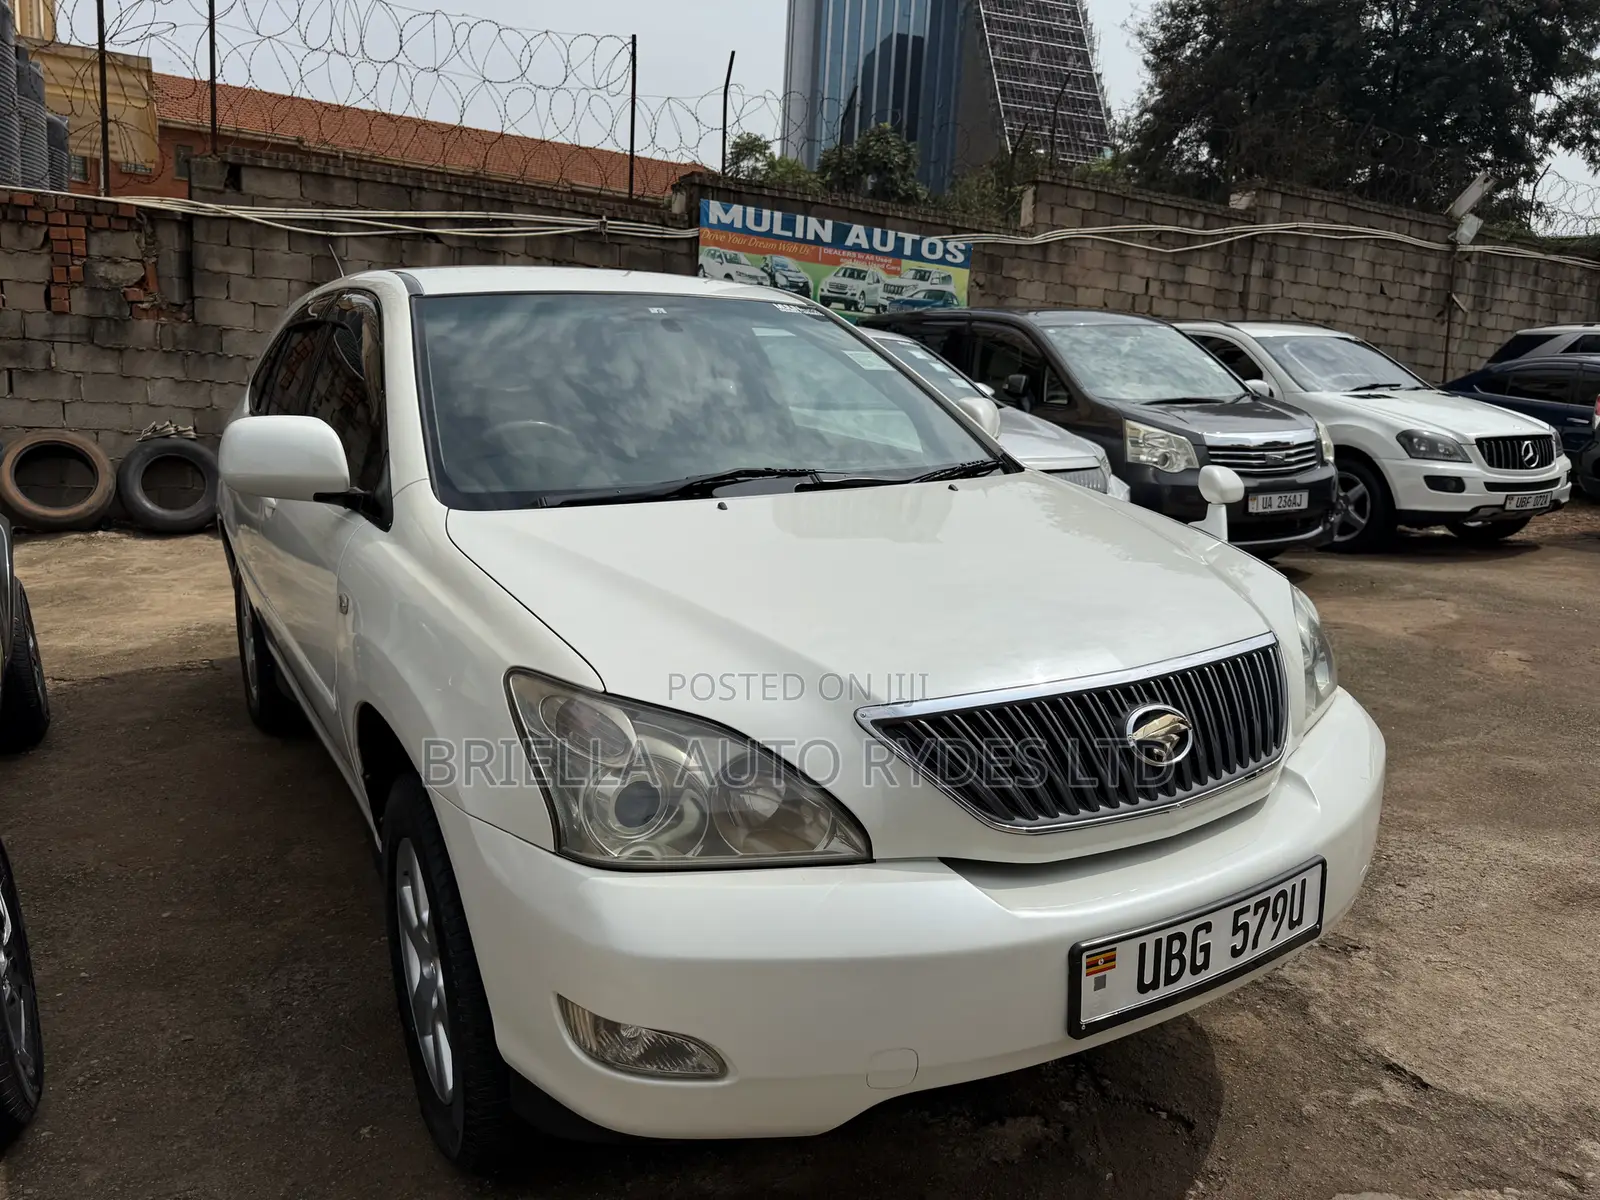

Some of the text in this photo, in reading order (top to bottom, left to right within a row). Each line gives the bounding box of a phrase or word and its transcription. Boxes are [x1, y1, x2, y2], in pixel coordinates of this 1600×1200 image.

[708, 200, 968, 263] MULIN AUTOS
[727, 233, 748, 244] Your
[748, 237, 777, 249] Dream
[779, 242, 798, 252] With
[823, 248, 857, 258] DEALERS
[875, 255, 893, 263] Used
[1262, 493, 1303, 510] UA 236AJ
[1515, 496, 1532, 508] UBF
[1136, 877, 1308, 995] UBG 579U
